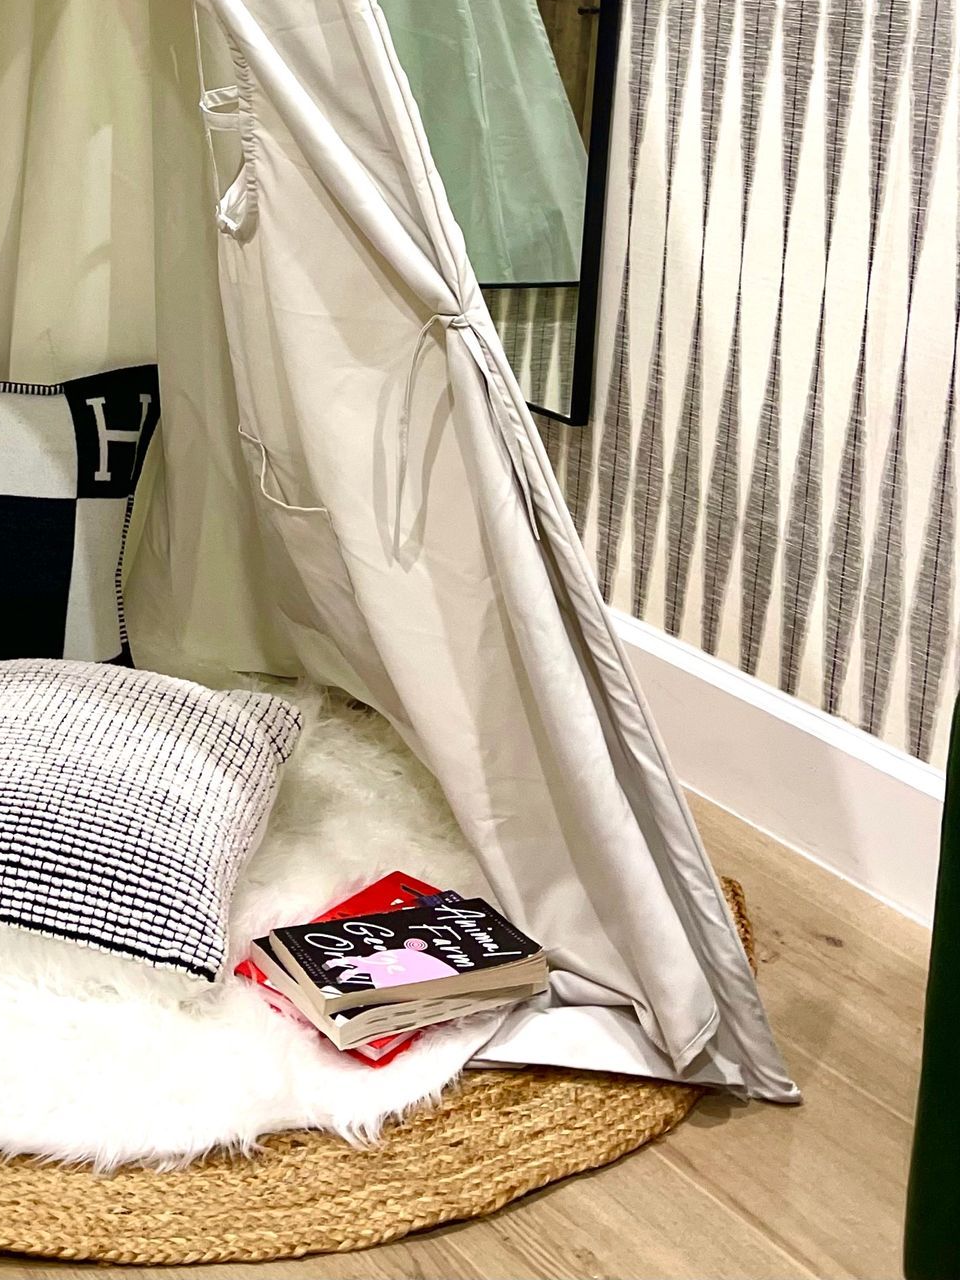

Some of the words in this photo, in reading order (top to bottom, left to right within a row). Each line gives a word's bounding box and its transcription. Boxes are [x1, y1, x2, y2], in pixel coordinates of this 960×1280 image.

[408, 923, 475, 967] Farm
[434, 904, 522, 957] Animal
[304, 933, 375, 984] Orwll
